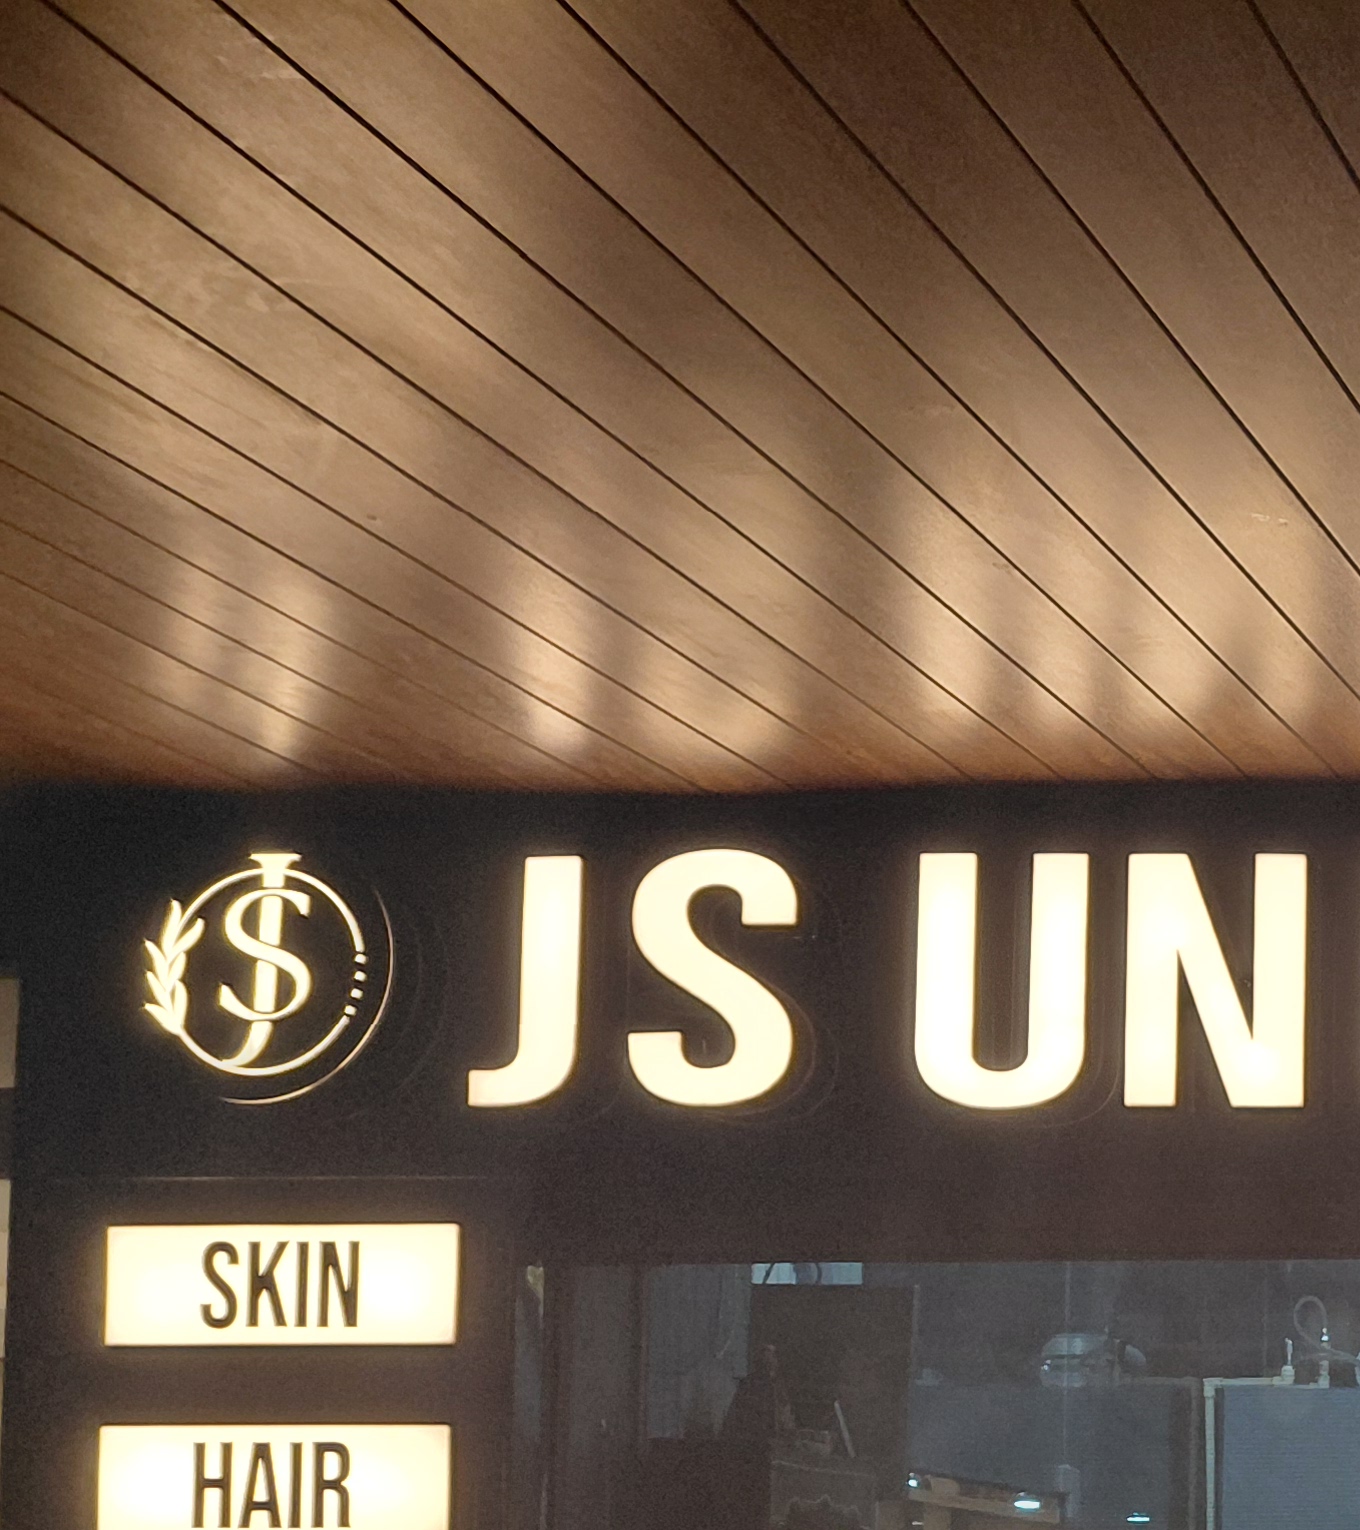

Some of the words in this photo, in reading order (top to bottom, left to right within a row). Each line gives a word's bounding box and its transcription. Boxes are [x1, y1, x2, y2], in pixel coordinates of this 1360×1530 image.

[467, 848, 799, 1108] JS
[200, 1240, 361, 1330] SKIN
[191, 1441, 352, 1530] HAIR
